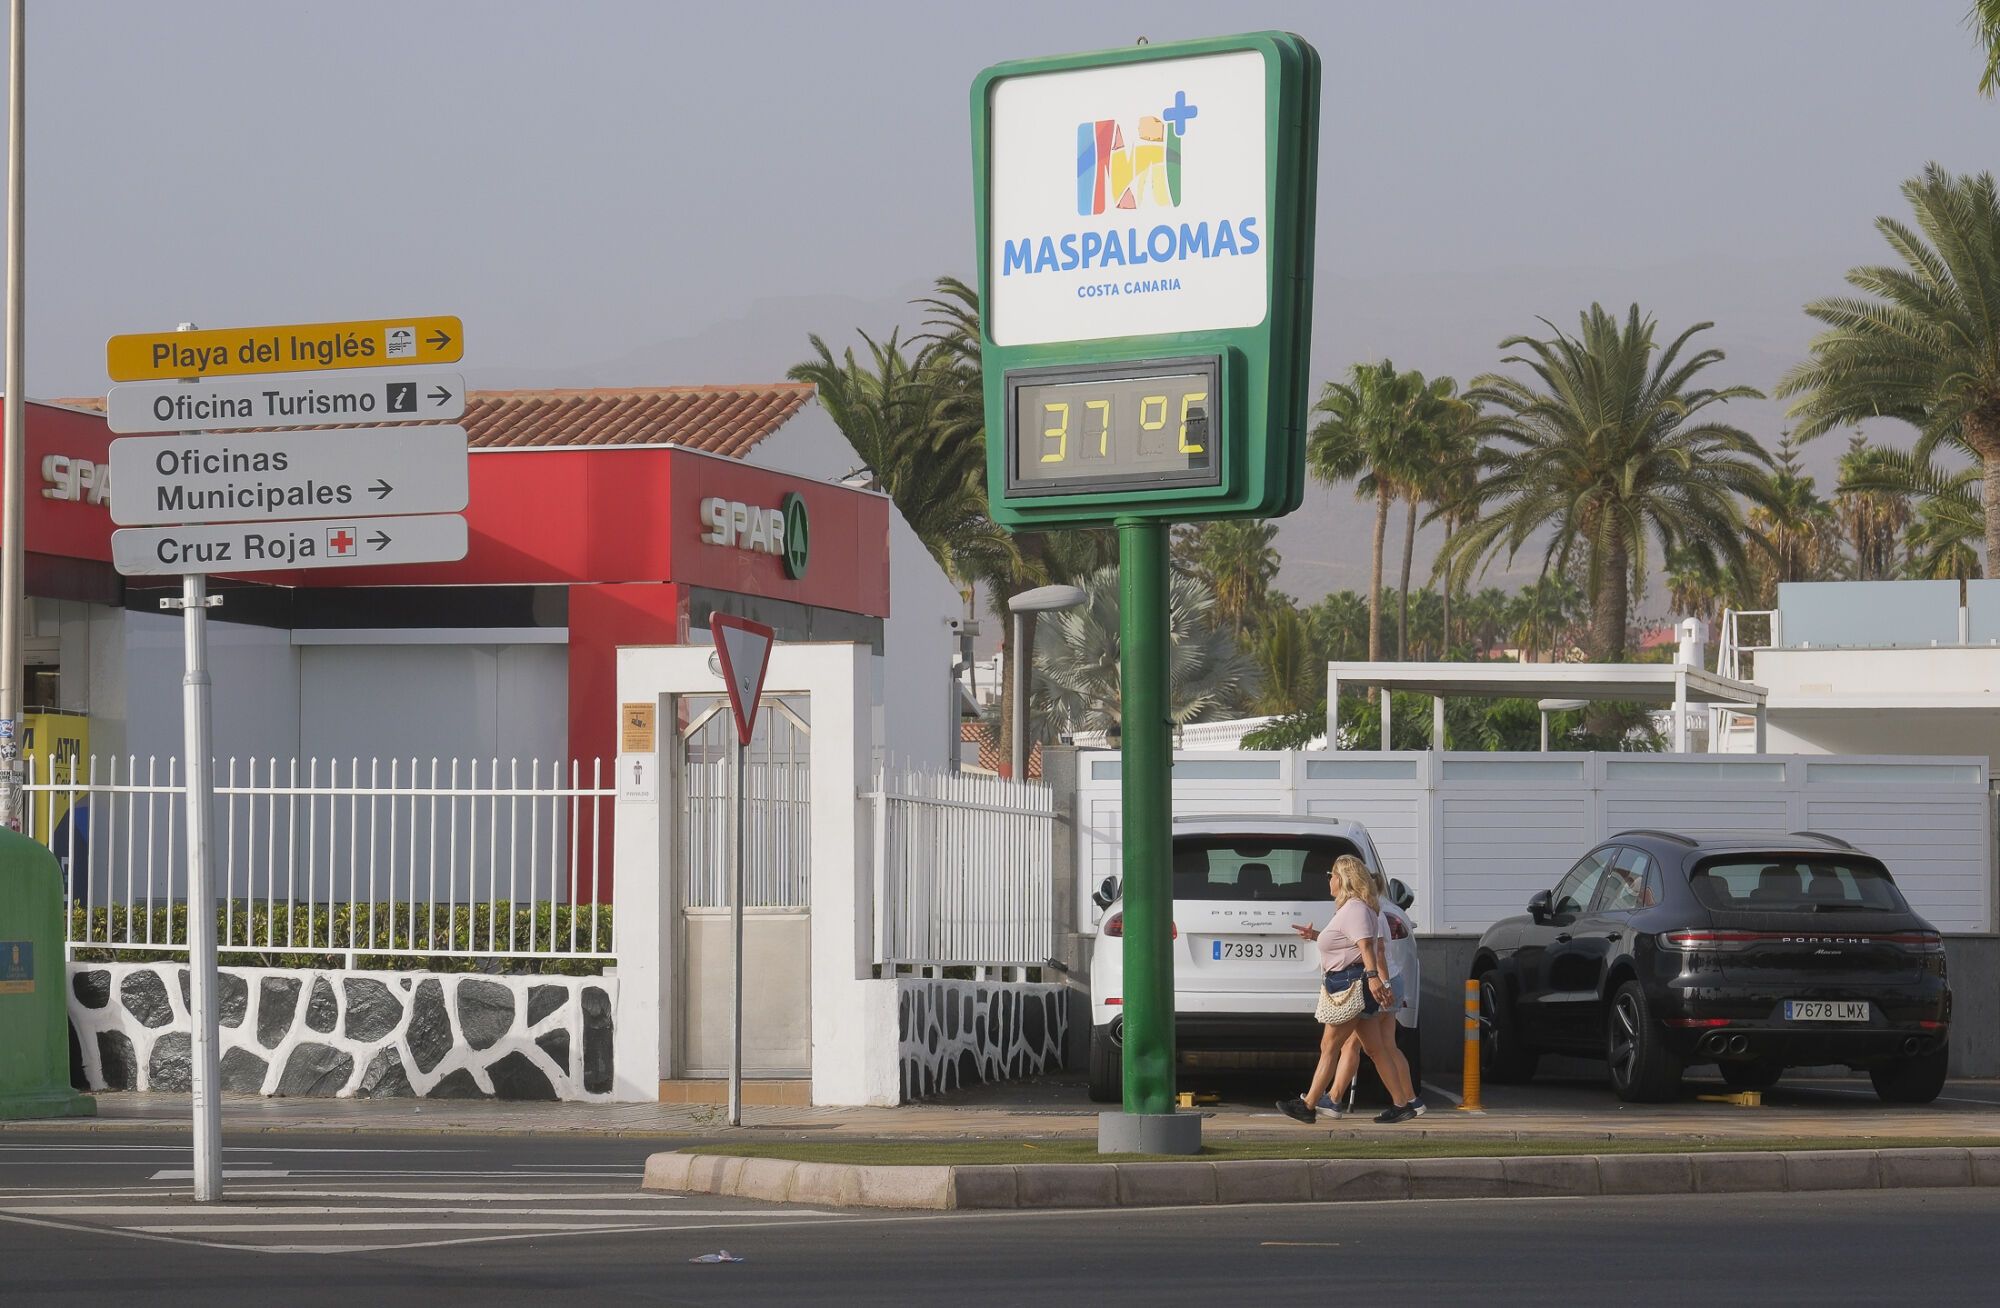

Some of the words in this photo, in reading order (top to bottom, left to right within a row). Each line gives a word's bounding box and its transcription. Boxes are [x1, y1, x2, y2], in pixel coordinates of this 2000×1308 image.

[1002, 216, 1260, 276] MASPALOMAS
[1077, 282, 1120, 298] COSTA
[1123, 278, 1182, 294] CANARIA
[152, 342, 229, 372] Playa
[238, 336, 280, 364] del
[290, 331, 376, 366] Inglés
[153, 393, 253, 421] Oficina
[262, 389, 376, 416] Turismo
[155, 447, 289, 476] Oficinas
[42, 454, 111, 508] SPA
[157, 480, 353, 513] Municipales
[700, 497, 786, 556] SPAR
[156, 537, 232, 564] Cruz
[244, 532, 316, 564] Roja
[55, 737, 80, 765] ATM
[1224, 943, 1264, 958] 7393
[1270, 943, 1297, 958] JVR
[1795, 1002, 1833, 1018] 7678
[1838, 1003, 1864, 1018] LMX
